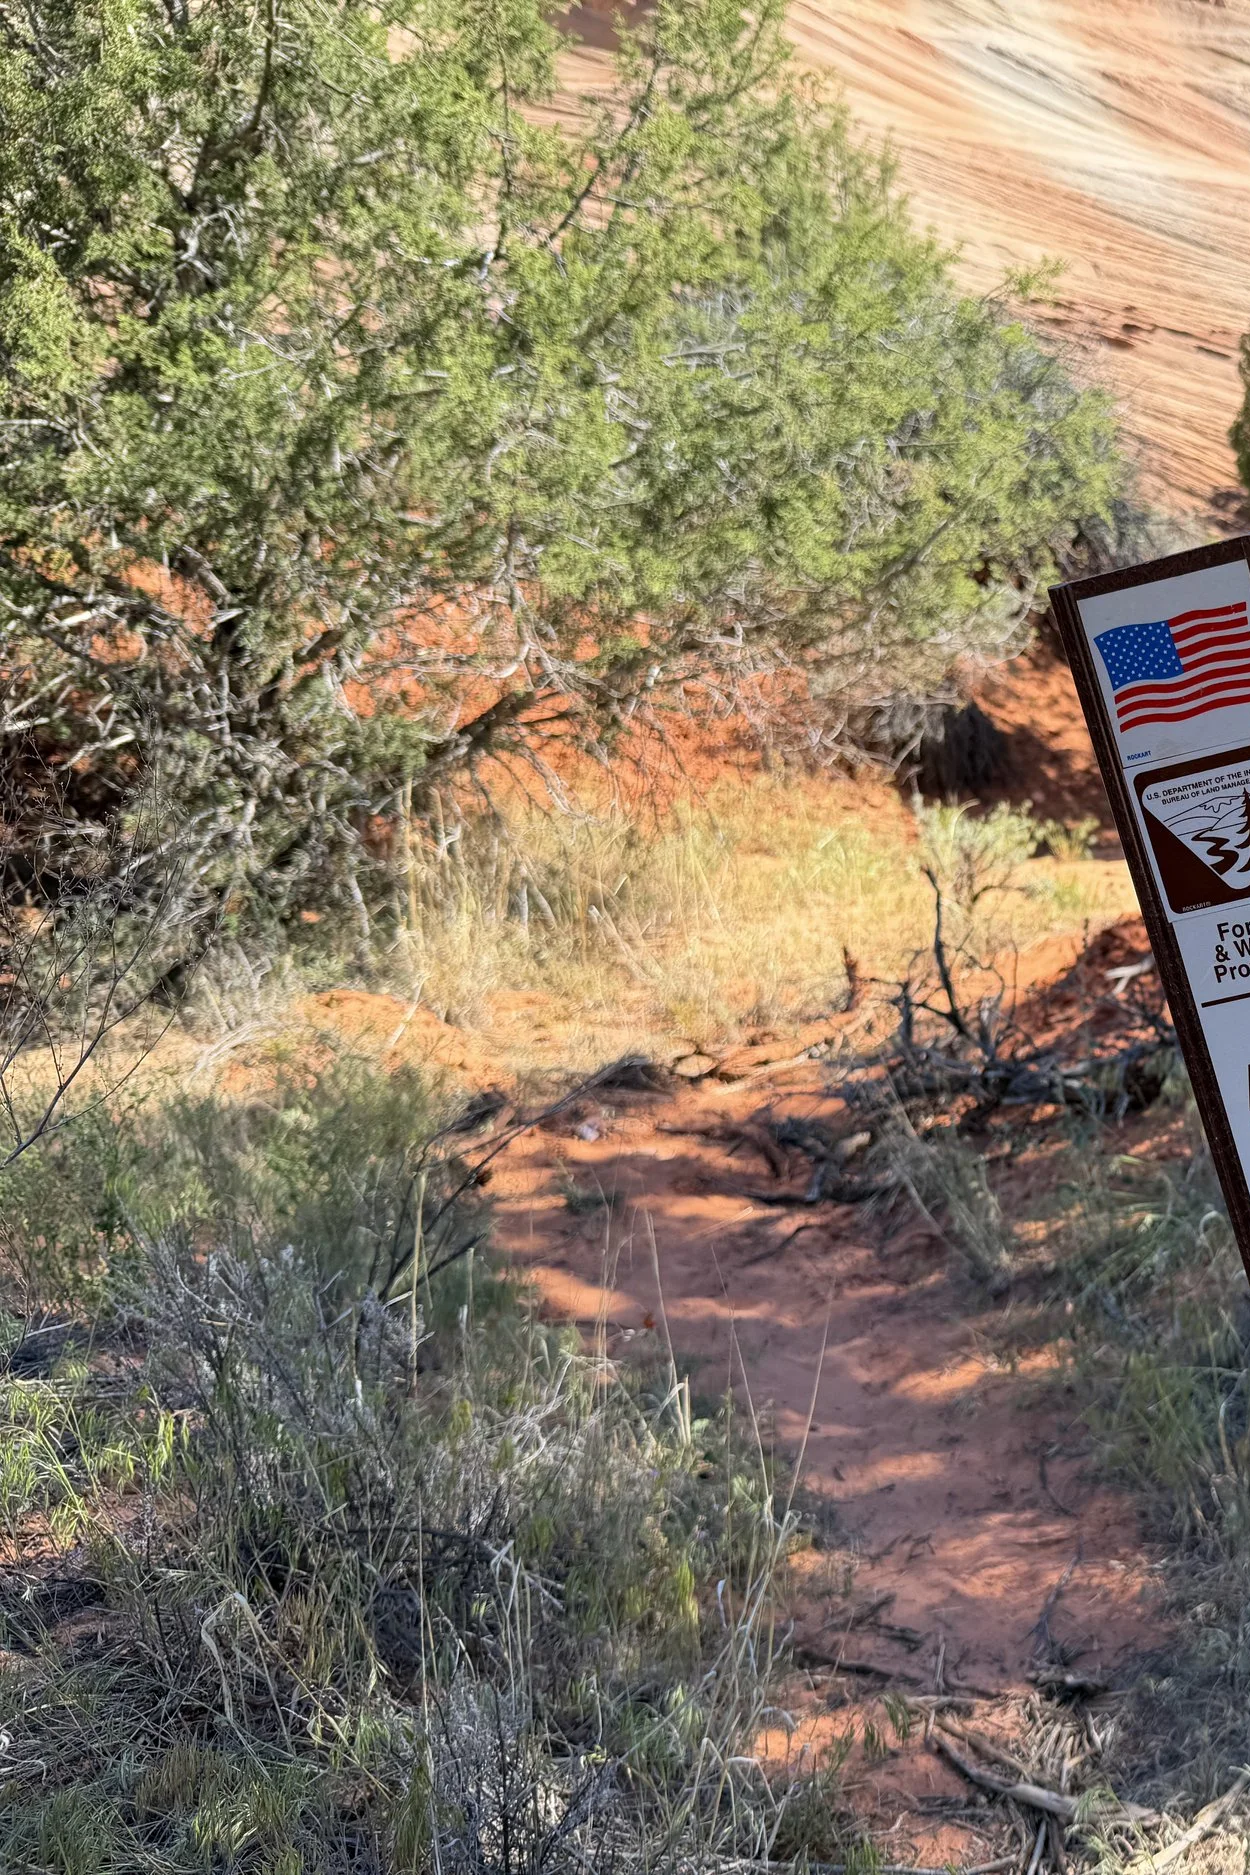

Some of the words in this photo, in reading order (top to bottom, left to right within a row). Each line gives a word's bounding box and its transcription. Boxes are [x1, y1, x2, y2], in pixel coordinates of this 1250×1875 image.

[1146, 792, 1161, 801] U.S.
[1162, 779, 1213, 797] DEPARTMENT
[1214, 775, 1225, 784] OF
[1226, 771, 1242, 780] THE
[1161, 793, 1190, 805] BUREAU
[1190, 790, 1200, 798] OF
[1201, 785, 1220, 796] LAND
[1215, 944, 1231, 962] &
